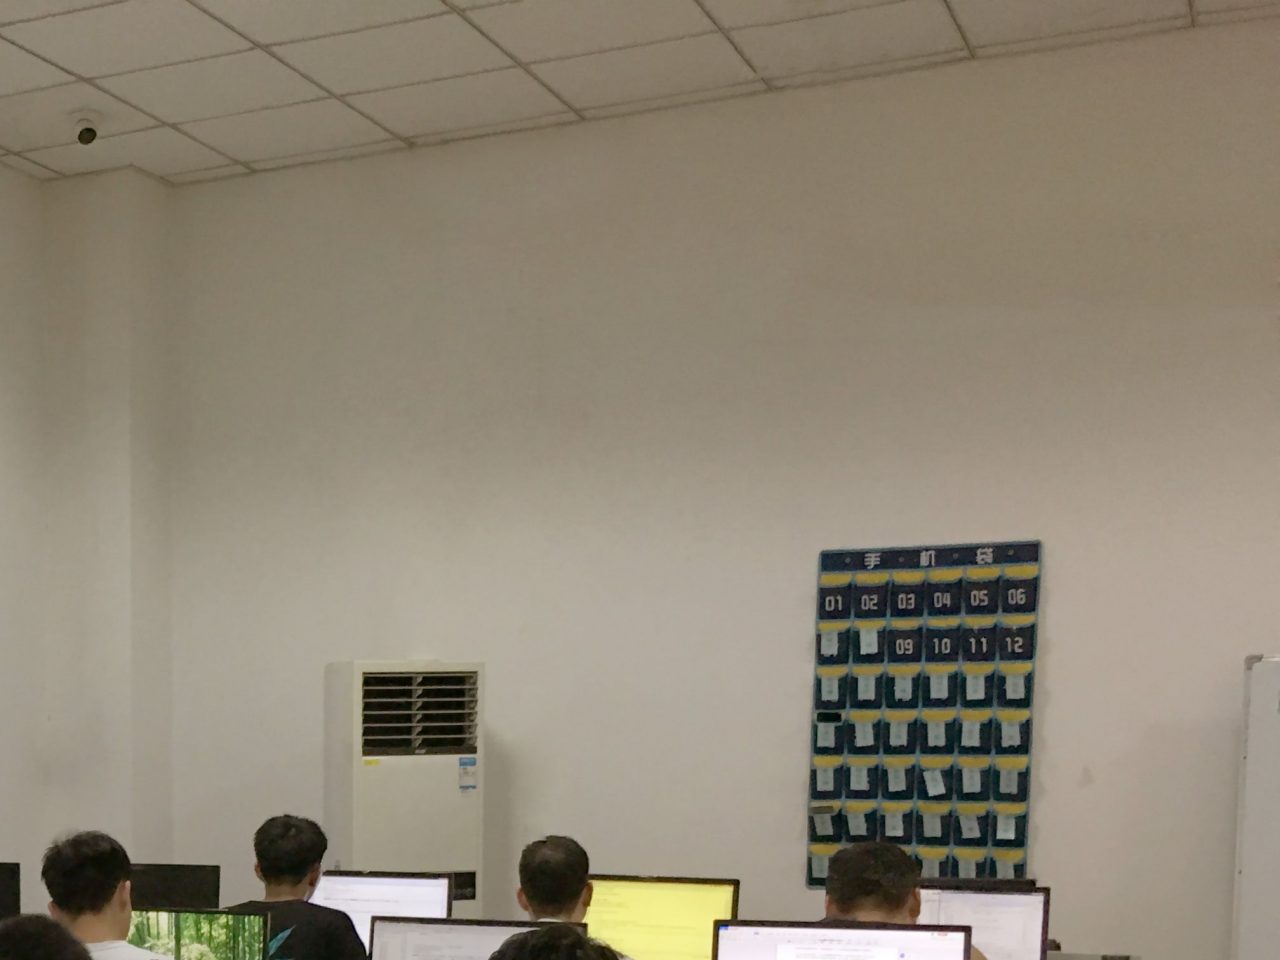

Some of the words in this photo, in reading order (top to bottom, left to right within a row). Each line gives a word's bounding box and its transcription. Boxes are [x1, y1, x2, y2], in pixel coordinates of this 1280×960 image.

[825, 595, 843, 611] 01
[861, 593, 878, 610] 02
[898, 592, 915, 609] 03
[933, 591, 951, 609] 04
[971, 590, 988, 606] 05
[1008, 588, 1026, 605] 06
[895, 638, 913, 655] 09
[933, 638, 951, 654] 10
[969, 637, 987, 654] 11
[1005, 637, 1023, 653] 12
